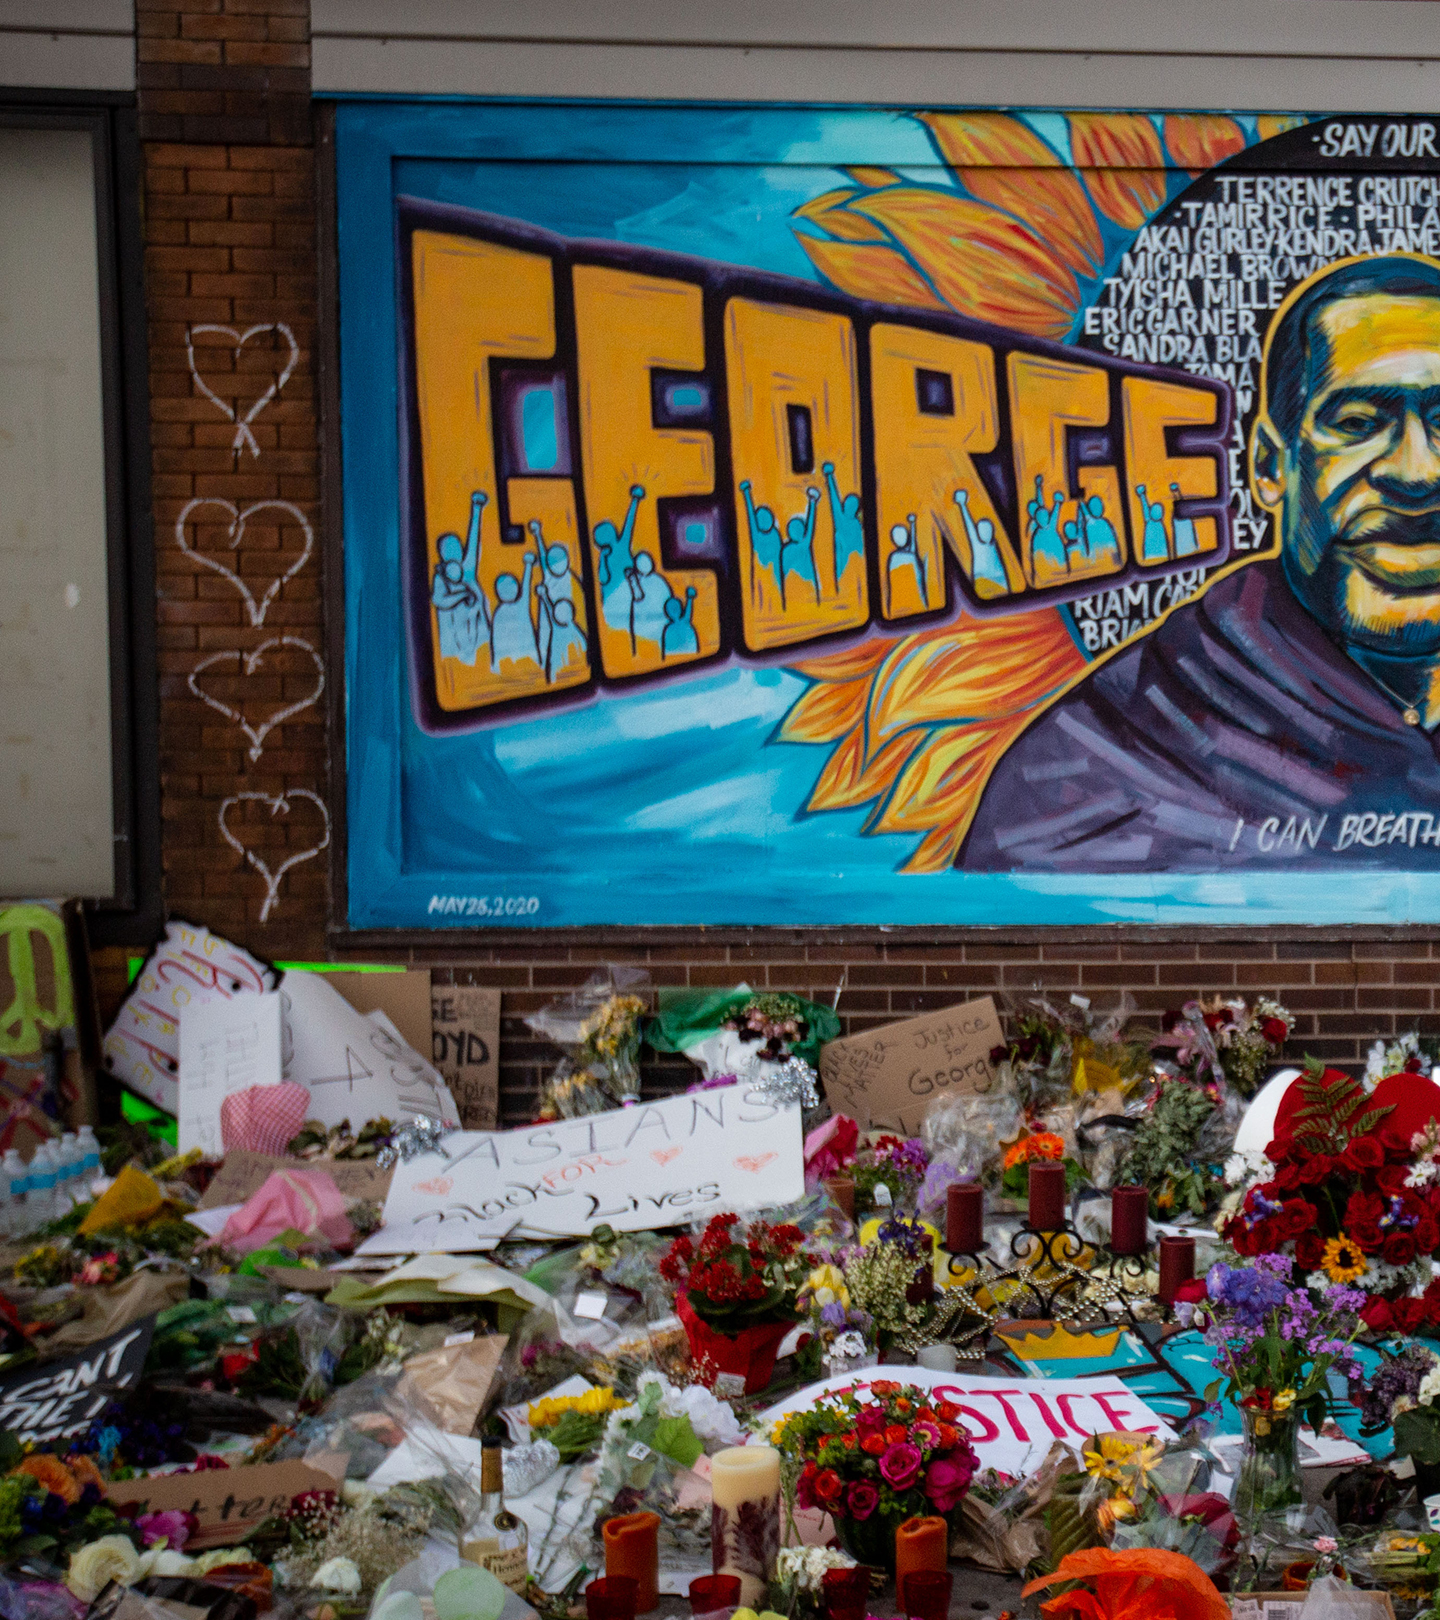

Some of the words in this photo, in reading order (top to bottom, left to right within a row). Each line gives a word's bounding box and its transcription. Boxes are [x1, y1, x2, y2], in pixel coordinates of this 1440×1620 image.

[1320, 123, 1379, 157] SAY
[1382, 123, 1440, 157] OUR
[1214, 177, 1353, 206] TERRENCE
[1182, 201, 1265, 230] TAMIR
[1267, 205, 1334, 231] RICE
[1133, 226, 1188, 252] AKAI
[1194, 227, 1276, 255] GURLEY
[1278, 228, 1375, 257] KENDRA
[1121, 253, 1234, 280] MICHAEL
[1103, 278, 1193, 310] TYISHA
[1204, 279, 1286, 310] MILLE
[1085, 307, 1143, 334] ERIC
[1146, 308, 1260, 337] GARNER
[1103, 334, 1208, 363] SANDRA
[1214, 334, 1263, 363] BLA
[405, 225, 1225, 715] GEORGE
[1229, 818, 1244, 851] I
[1258, 812, 1329, 852] CAN
[441, 1087, 783, 1174] ASIANS
[543, 1155, 629, 1190] FOR
[584, 1182, 722, 1223] Lives
